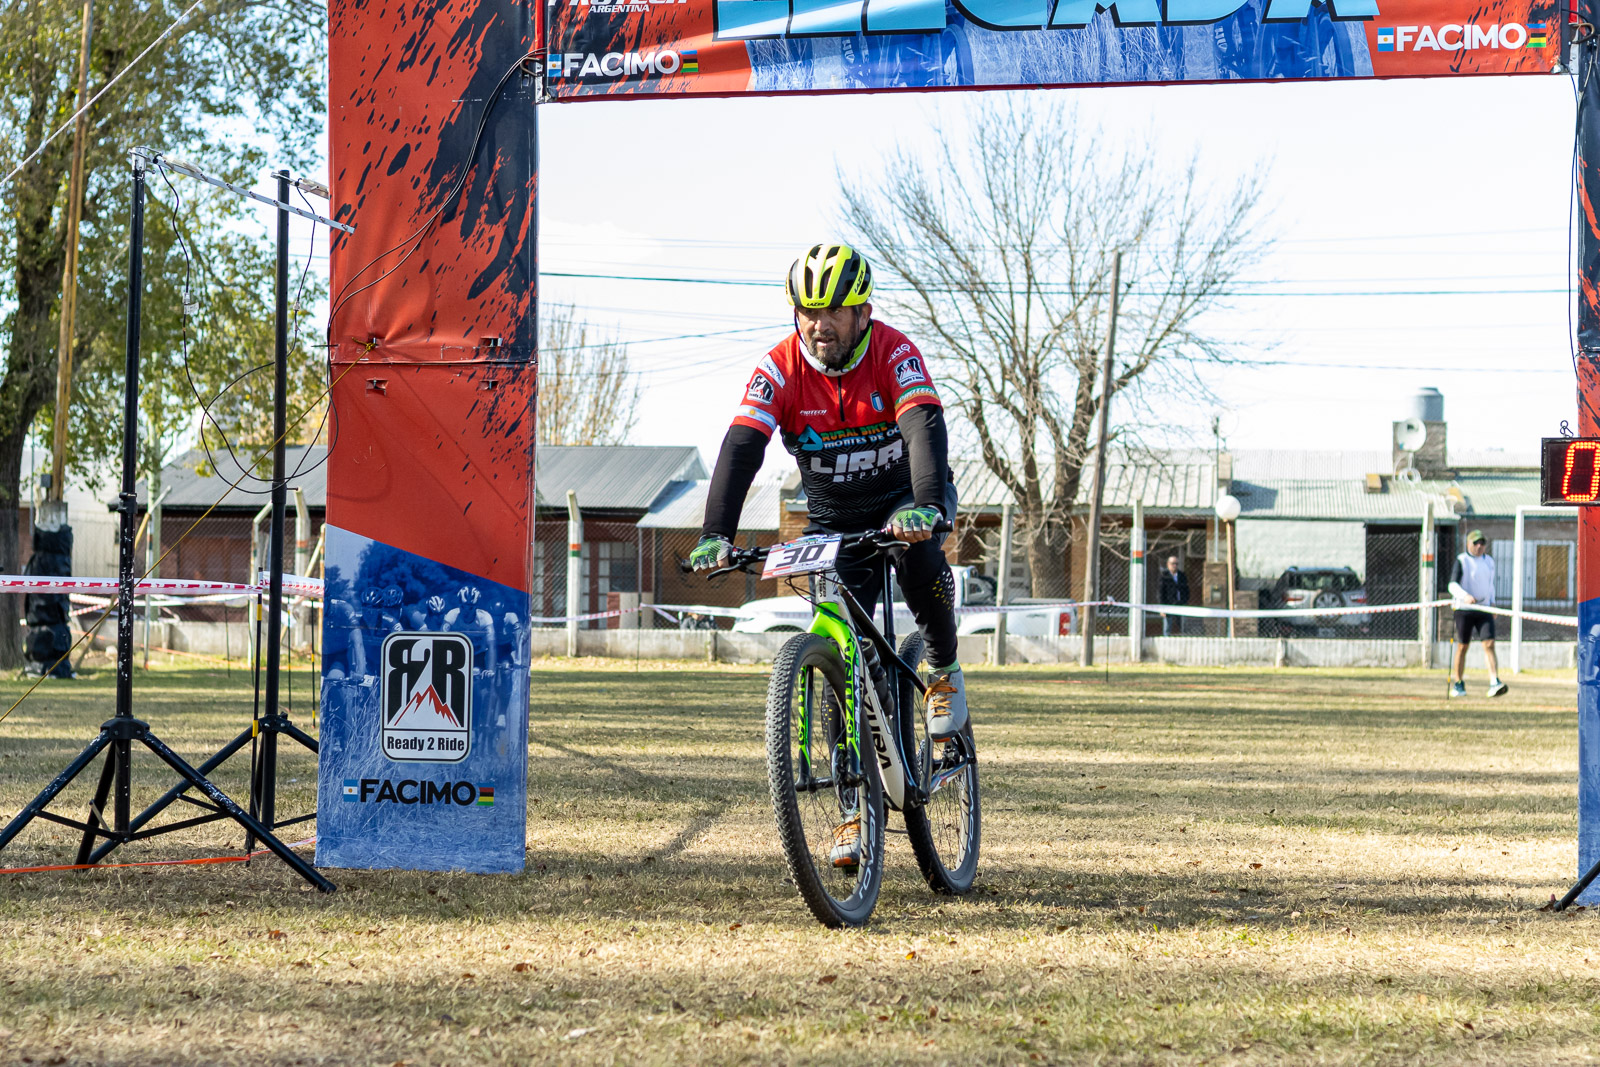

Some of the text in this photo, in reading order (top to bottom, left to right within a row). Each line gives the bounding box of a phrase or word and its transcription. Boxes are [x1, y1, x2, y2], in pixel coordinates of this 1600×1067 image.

[588, 4, 650, 13] ARGENTINA
[1396, 23, 1527, 52] FACIMO
[562, 50, 681, 77] FACIMO
[820, 422, 888, 442] RURAL BIKE
[869, 433, 884, 442] DE
[811, 439, 903, 474] LIRA
[1561, 440, 1600, 501] 0
[776, 543, 827, 568] 30
[387, 736, 465, 751] Ready 2 Ride
[360, 778, 476, 806] FACIMO
